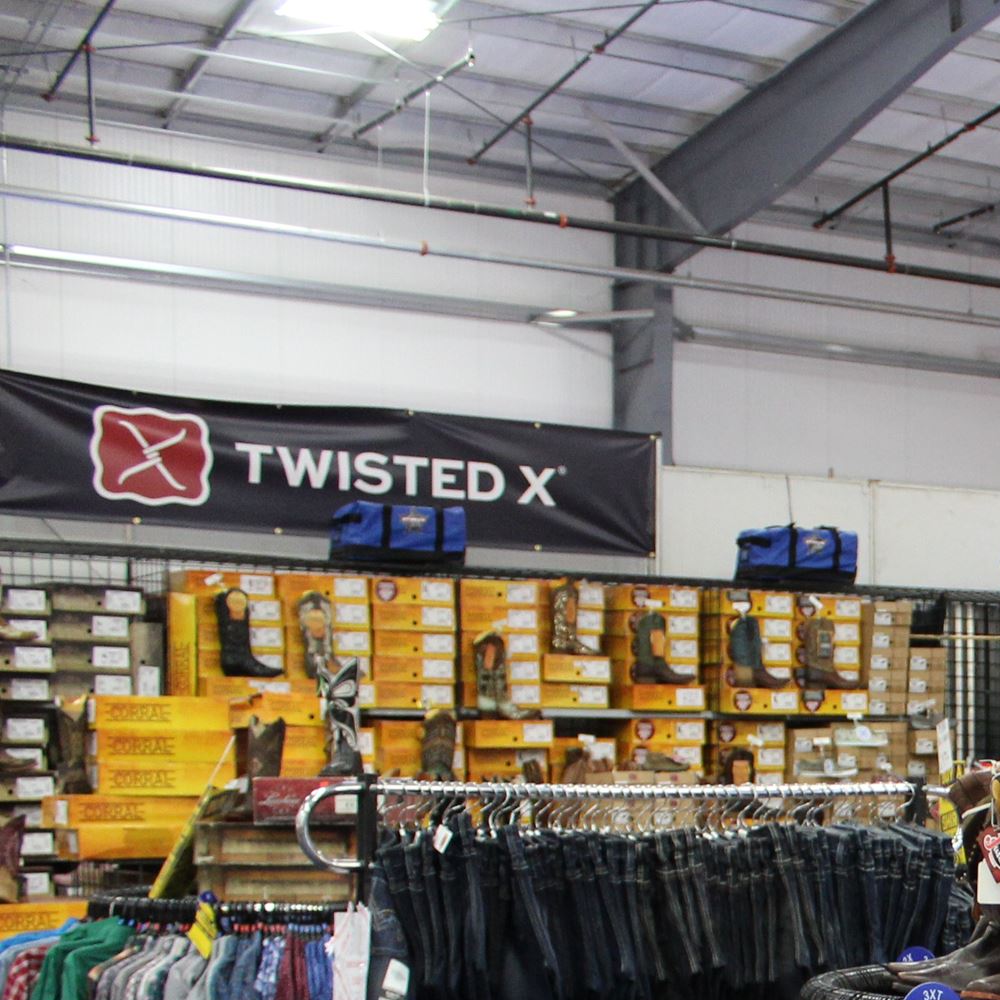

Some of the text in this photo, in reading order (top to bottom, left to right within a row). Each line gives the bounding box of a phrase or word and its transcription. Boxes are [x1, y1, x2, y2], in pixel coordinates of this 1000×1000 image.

[235, 442, 557, 506] TWISTED X
[110, 704, 167, 721] CORRAL
[112, 737, 170, 754] CORRAL
[113, 770, 170, 787] CORRAL
[0, 913, 51, 931] ORRAL
